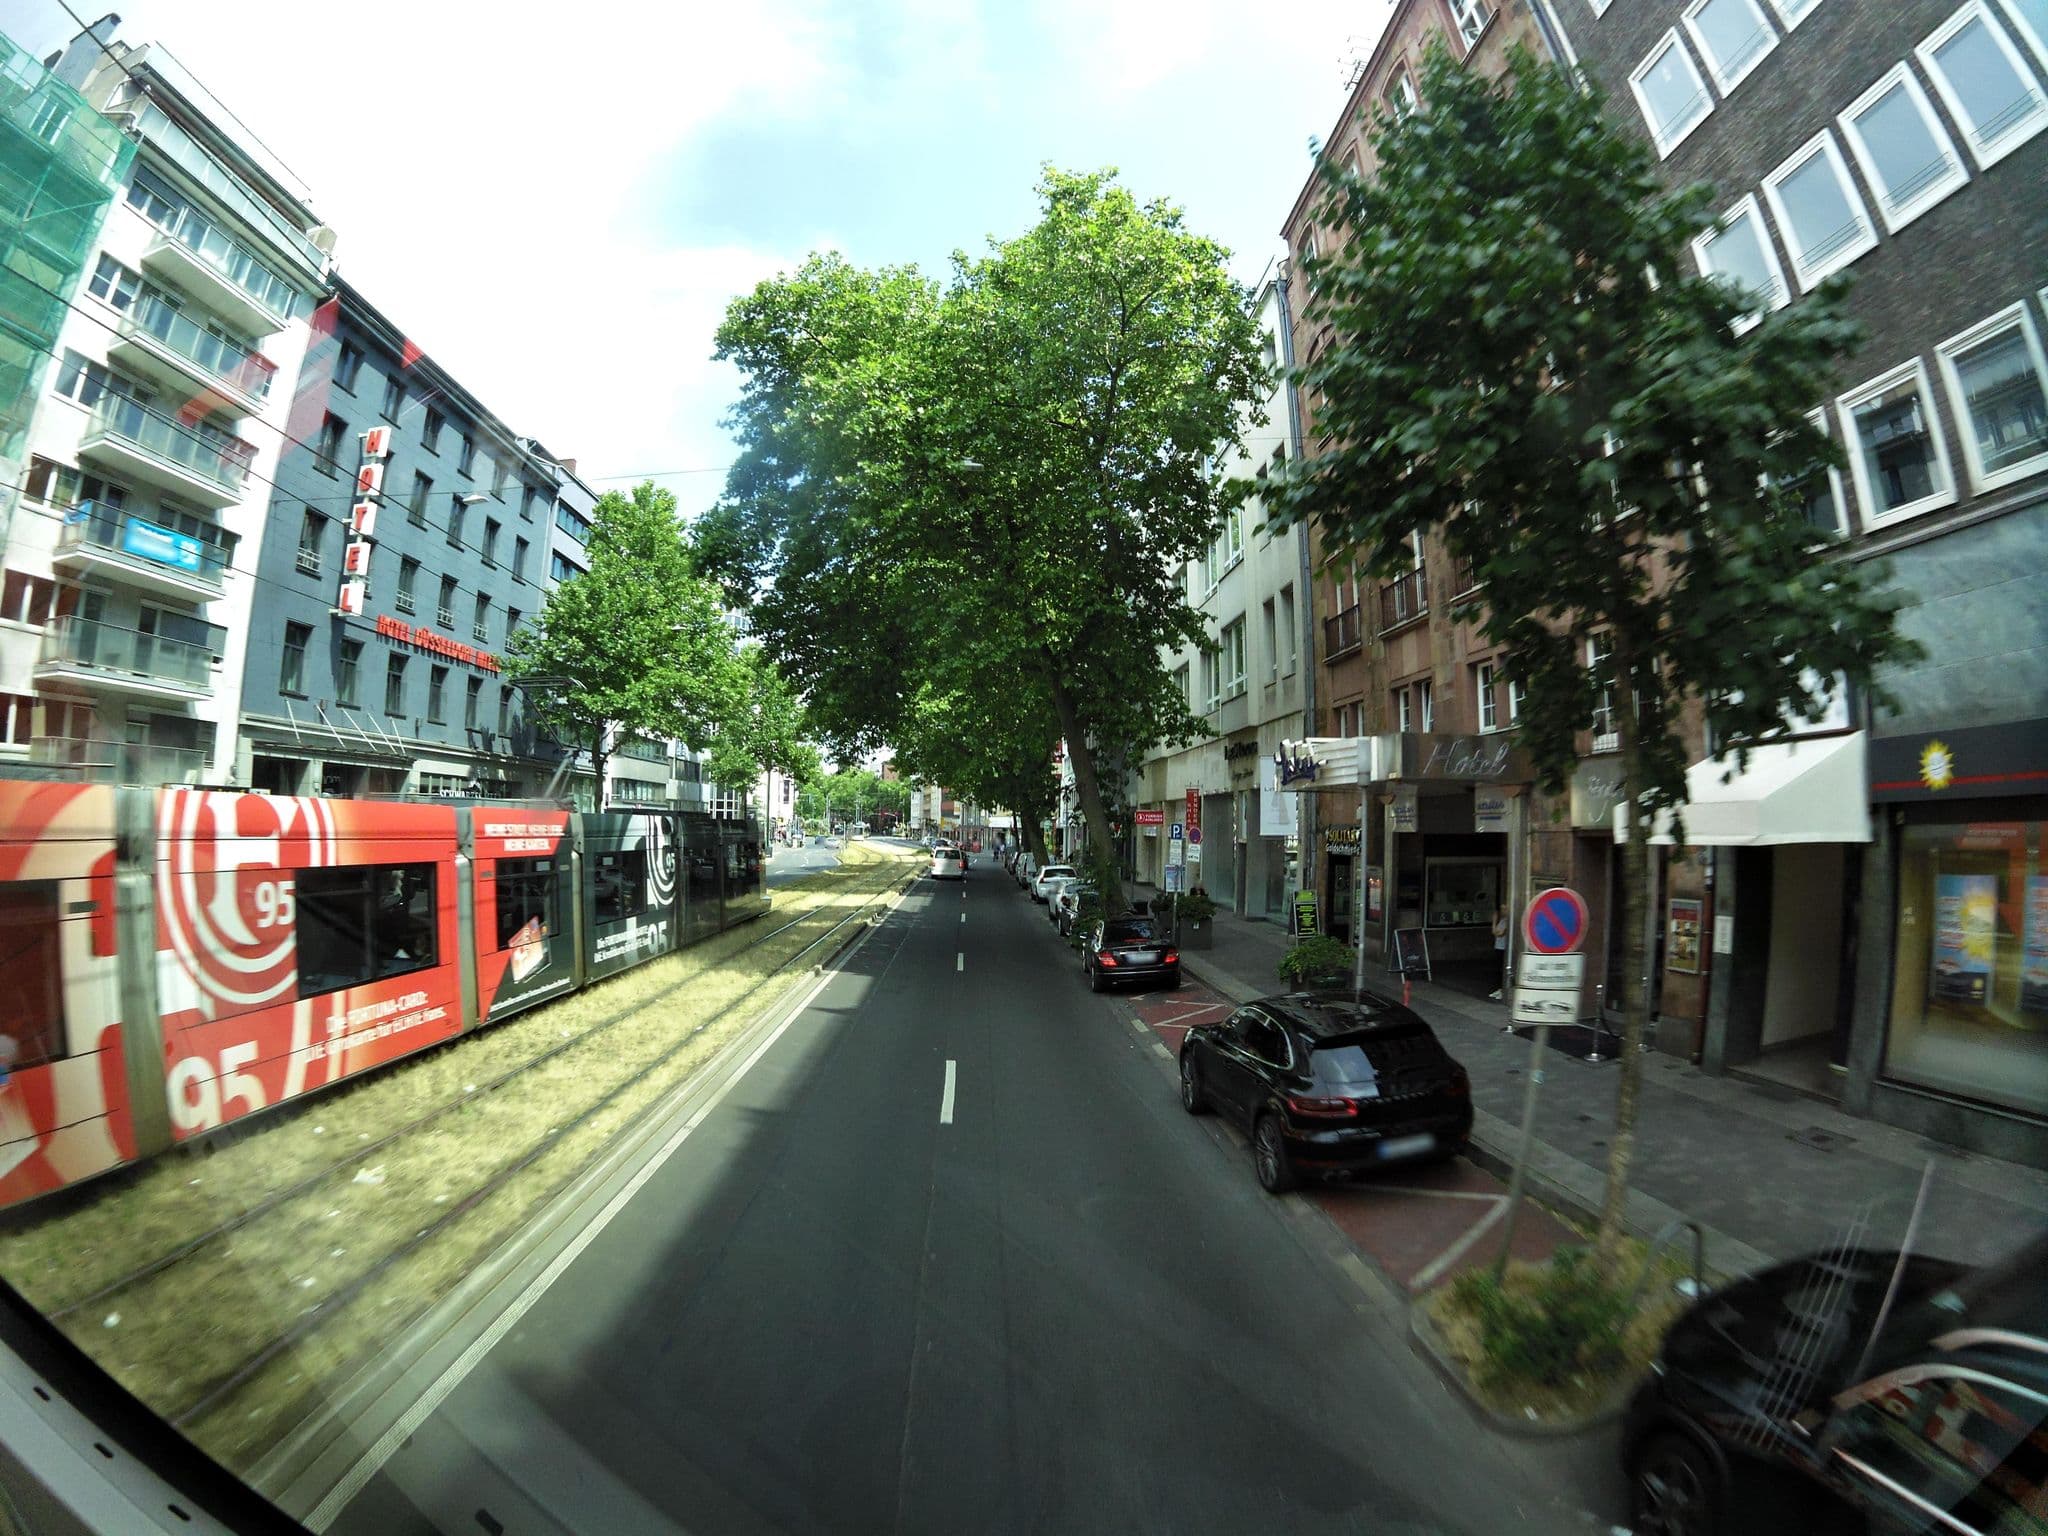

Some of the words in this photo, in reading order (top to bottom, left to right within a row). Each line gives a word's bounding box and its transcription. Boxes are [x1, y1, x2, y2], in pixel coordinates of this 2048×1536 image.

[340, 430, 383, 614] HOTEL
[376, 614, 410, 641] HOTEL
[1423, 739, 1510, 777] Hotel
[1173, 825, 1181, 838] P
[254, 880, 297, 928] 95
[167, 1040, 268, 1132] 95
